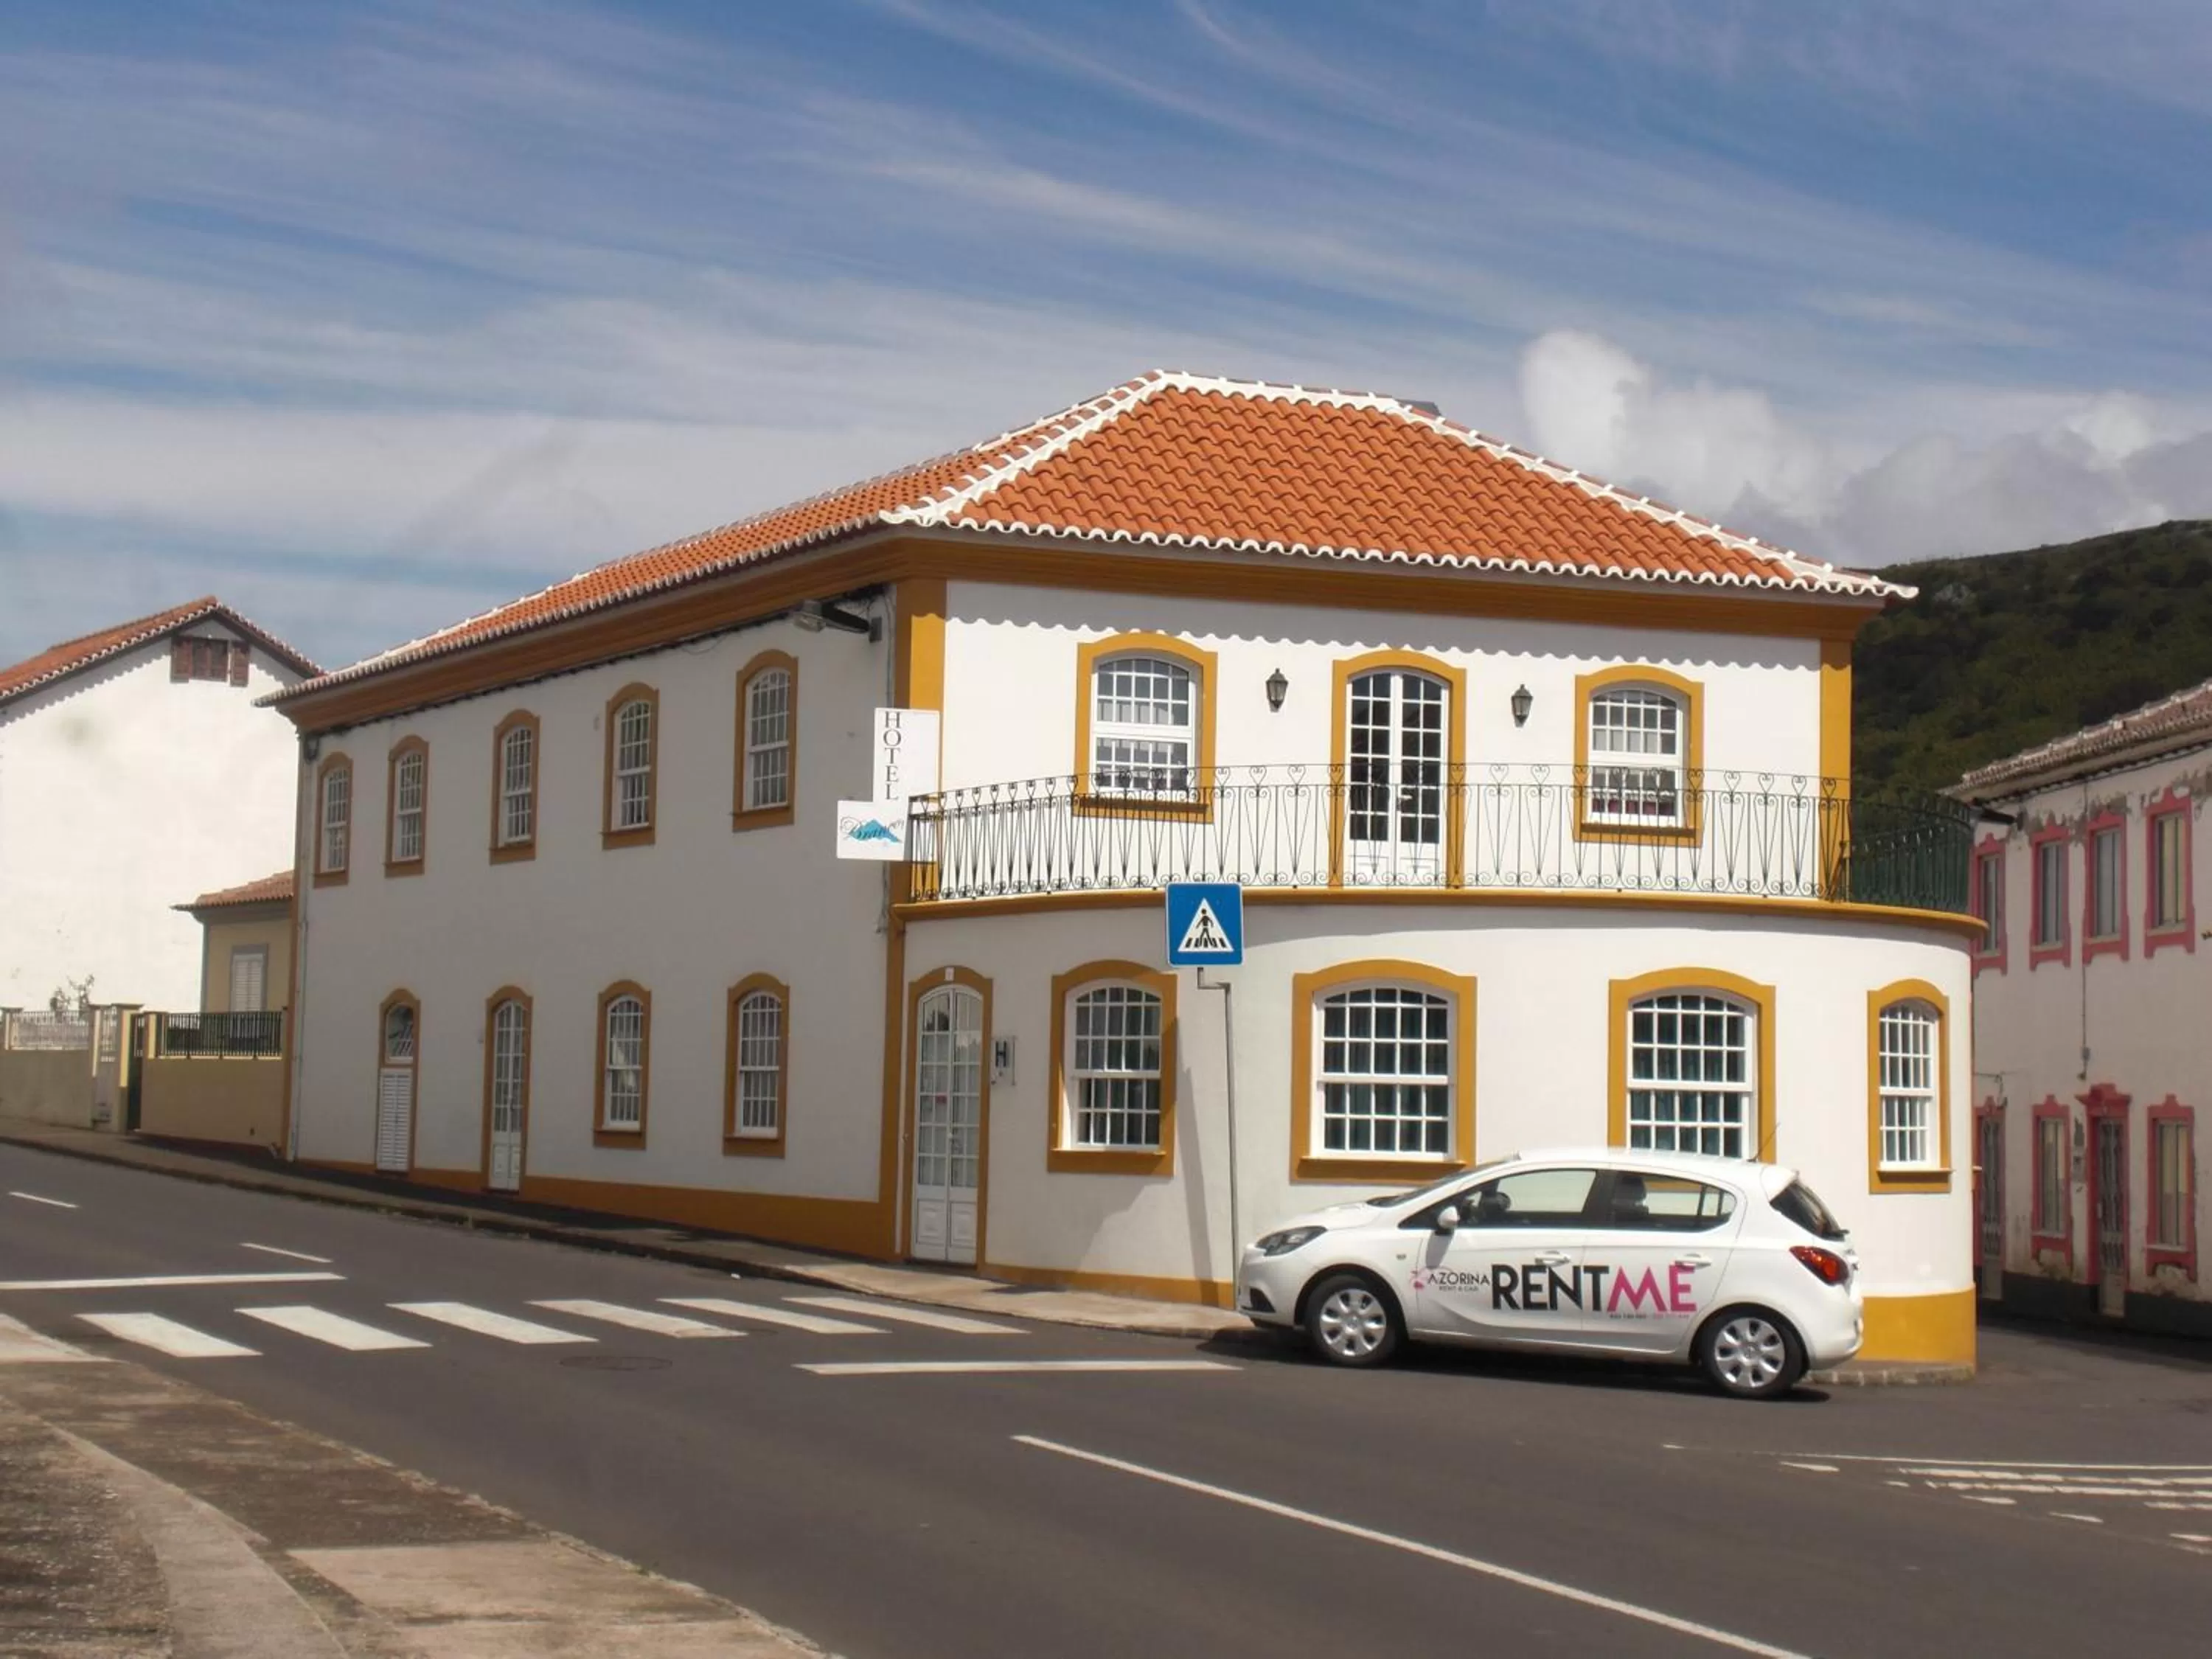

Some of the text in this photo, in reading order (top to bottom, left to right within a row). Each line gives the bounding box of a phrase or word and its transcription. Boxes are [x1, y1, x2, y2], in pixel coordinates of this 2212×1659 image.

[883, 711, 902, 800] HOTEL
[995, 1040, 1006, 1068] H
[1427, 1272, 1490, 1285] AZORINA
